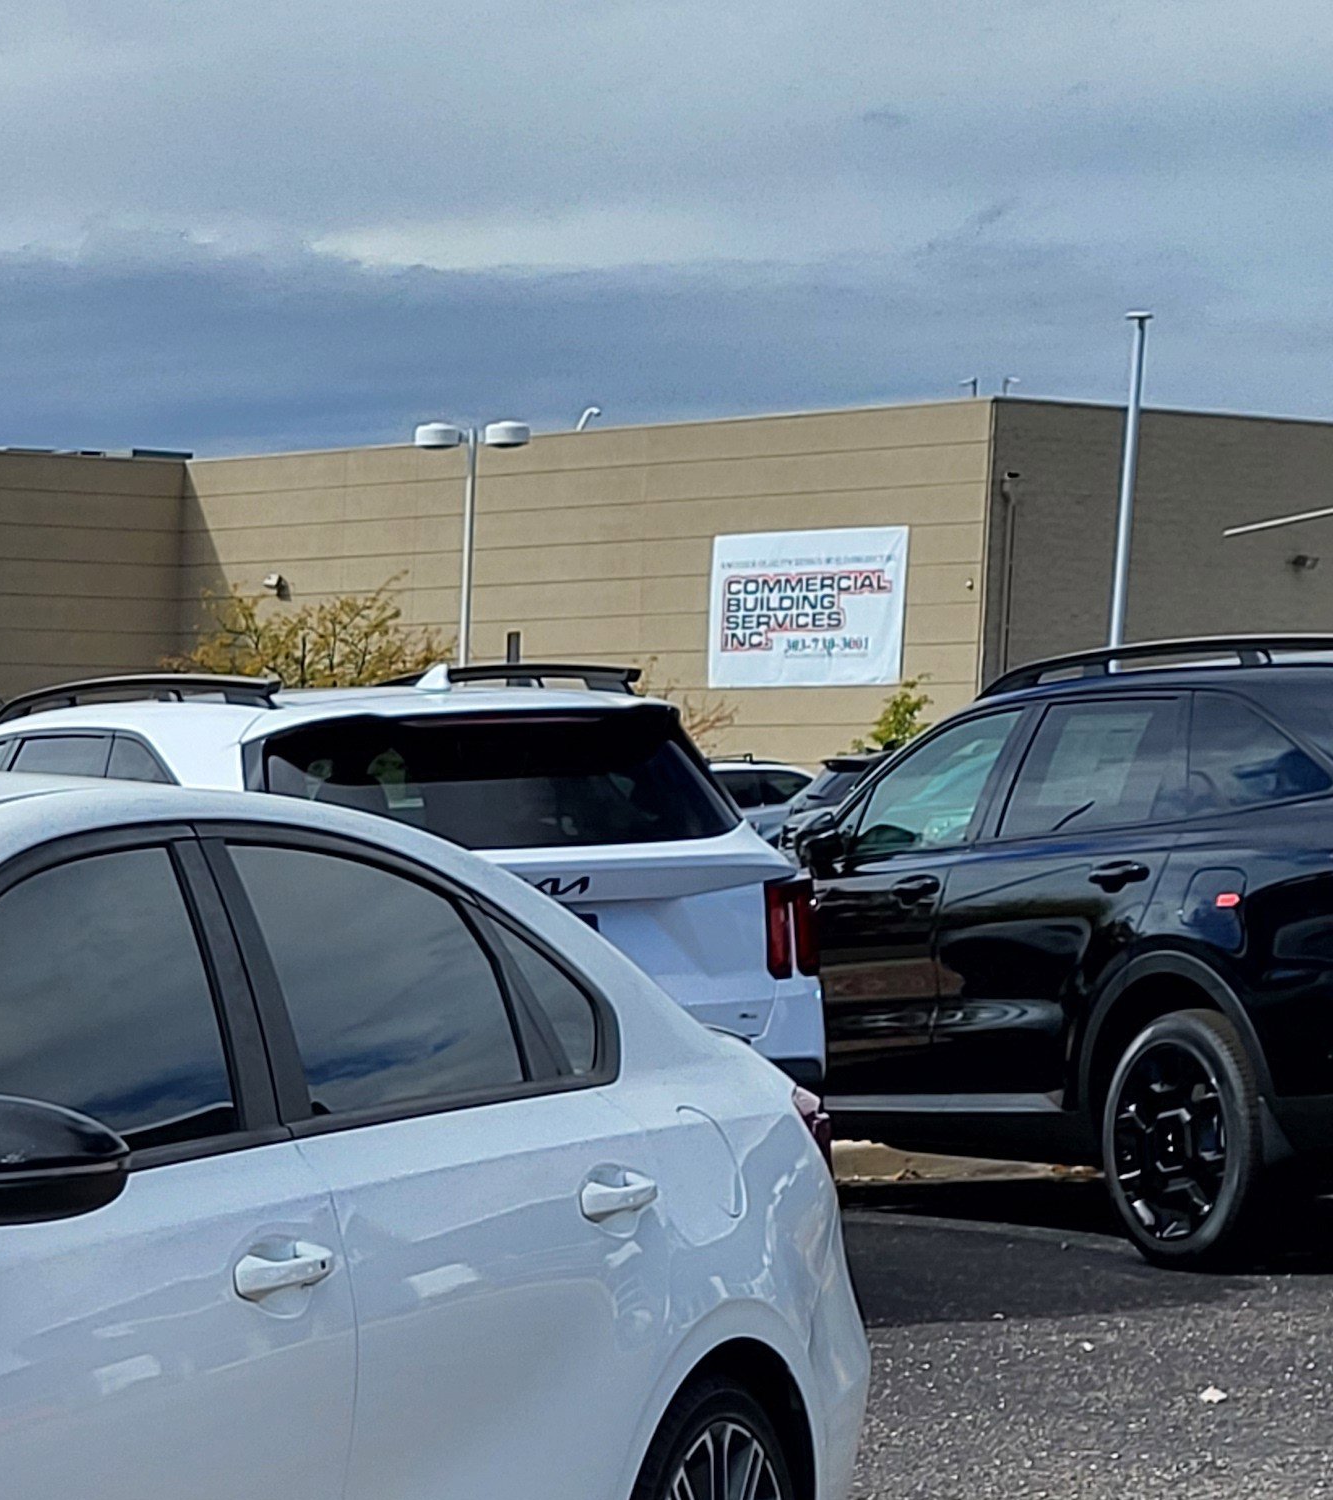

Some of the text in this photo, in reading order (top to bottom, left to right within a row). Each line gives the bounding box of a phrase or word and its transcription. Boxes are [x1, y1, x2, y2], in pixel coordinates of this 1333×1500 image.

[726, 574, 889, 596] COMMERCIAL
[725, 594, 837, 614] BUILDING
[724, 611, 843, 631] SERVICES
[722, 631, 772, 649] INC.
